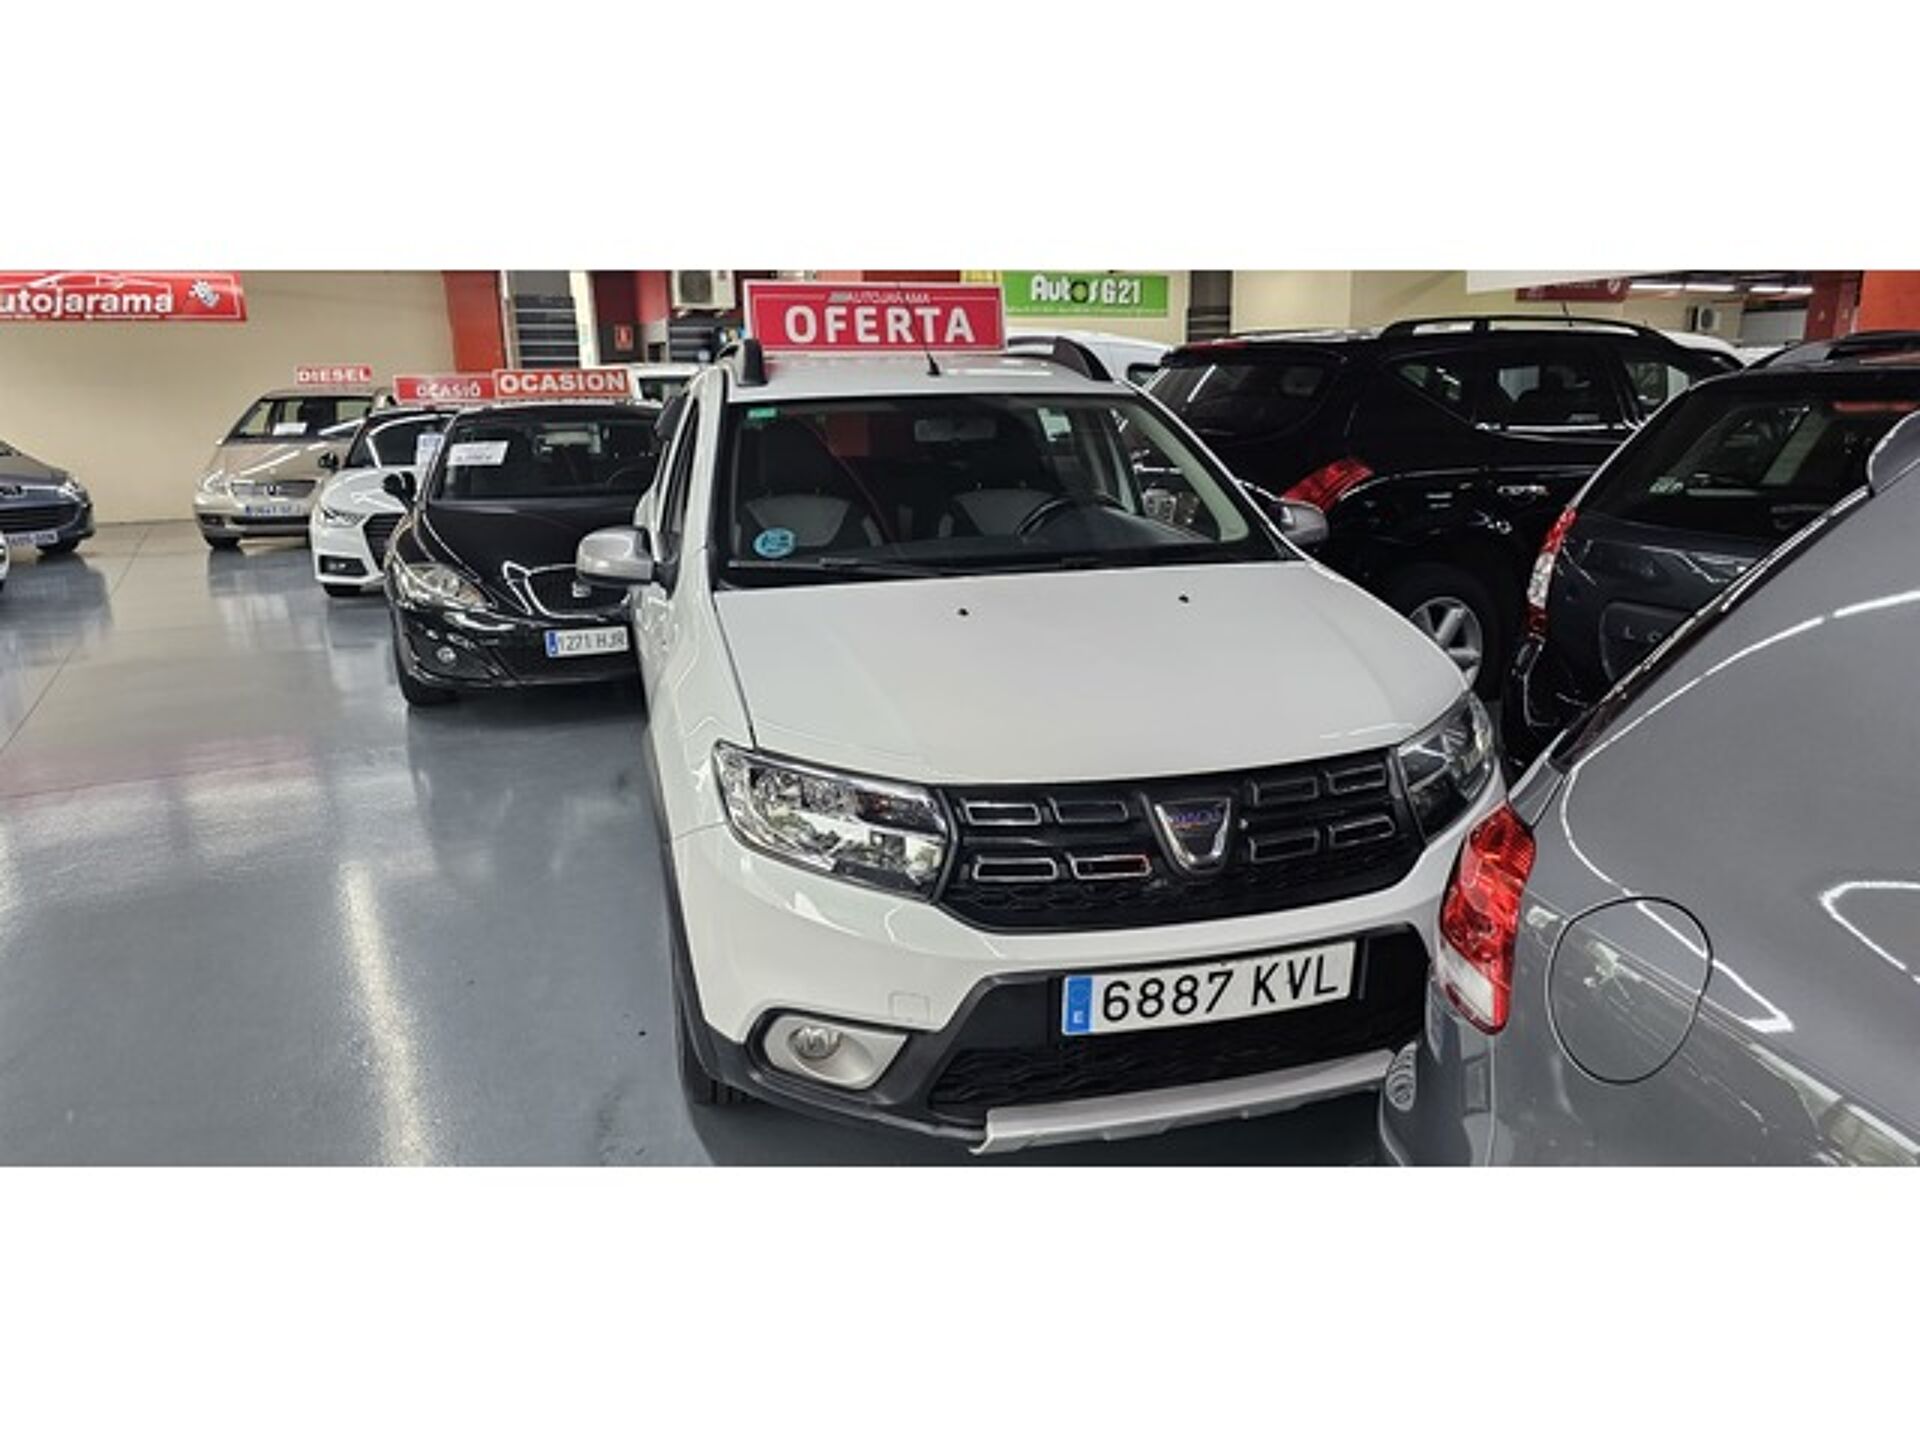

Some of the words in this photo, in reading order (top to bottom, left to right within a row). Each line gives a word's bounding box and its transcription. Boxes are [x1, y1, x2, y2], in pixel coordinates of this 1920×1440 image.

[0, 286, 174, 318] utojarama
[1031, 274, 1099, 304] Autos
[1103, 279, 1142, 305] G21
[785, 305, 976, 344] OFERTA
[298, 367, 371, 383] DIESEL
[500, 370, 625, 394] OCASION
[1102, 969, 1235, 1023] 6887
[1251, 954, 1339, 1007] KVL
[1072, 1010, 1084, 1024] E
